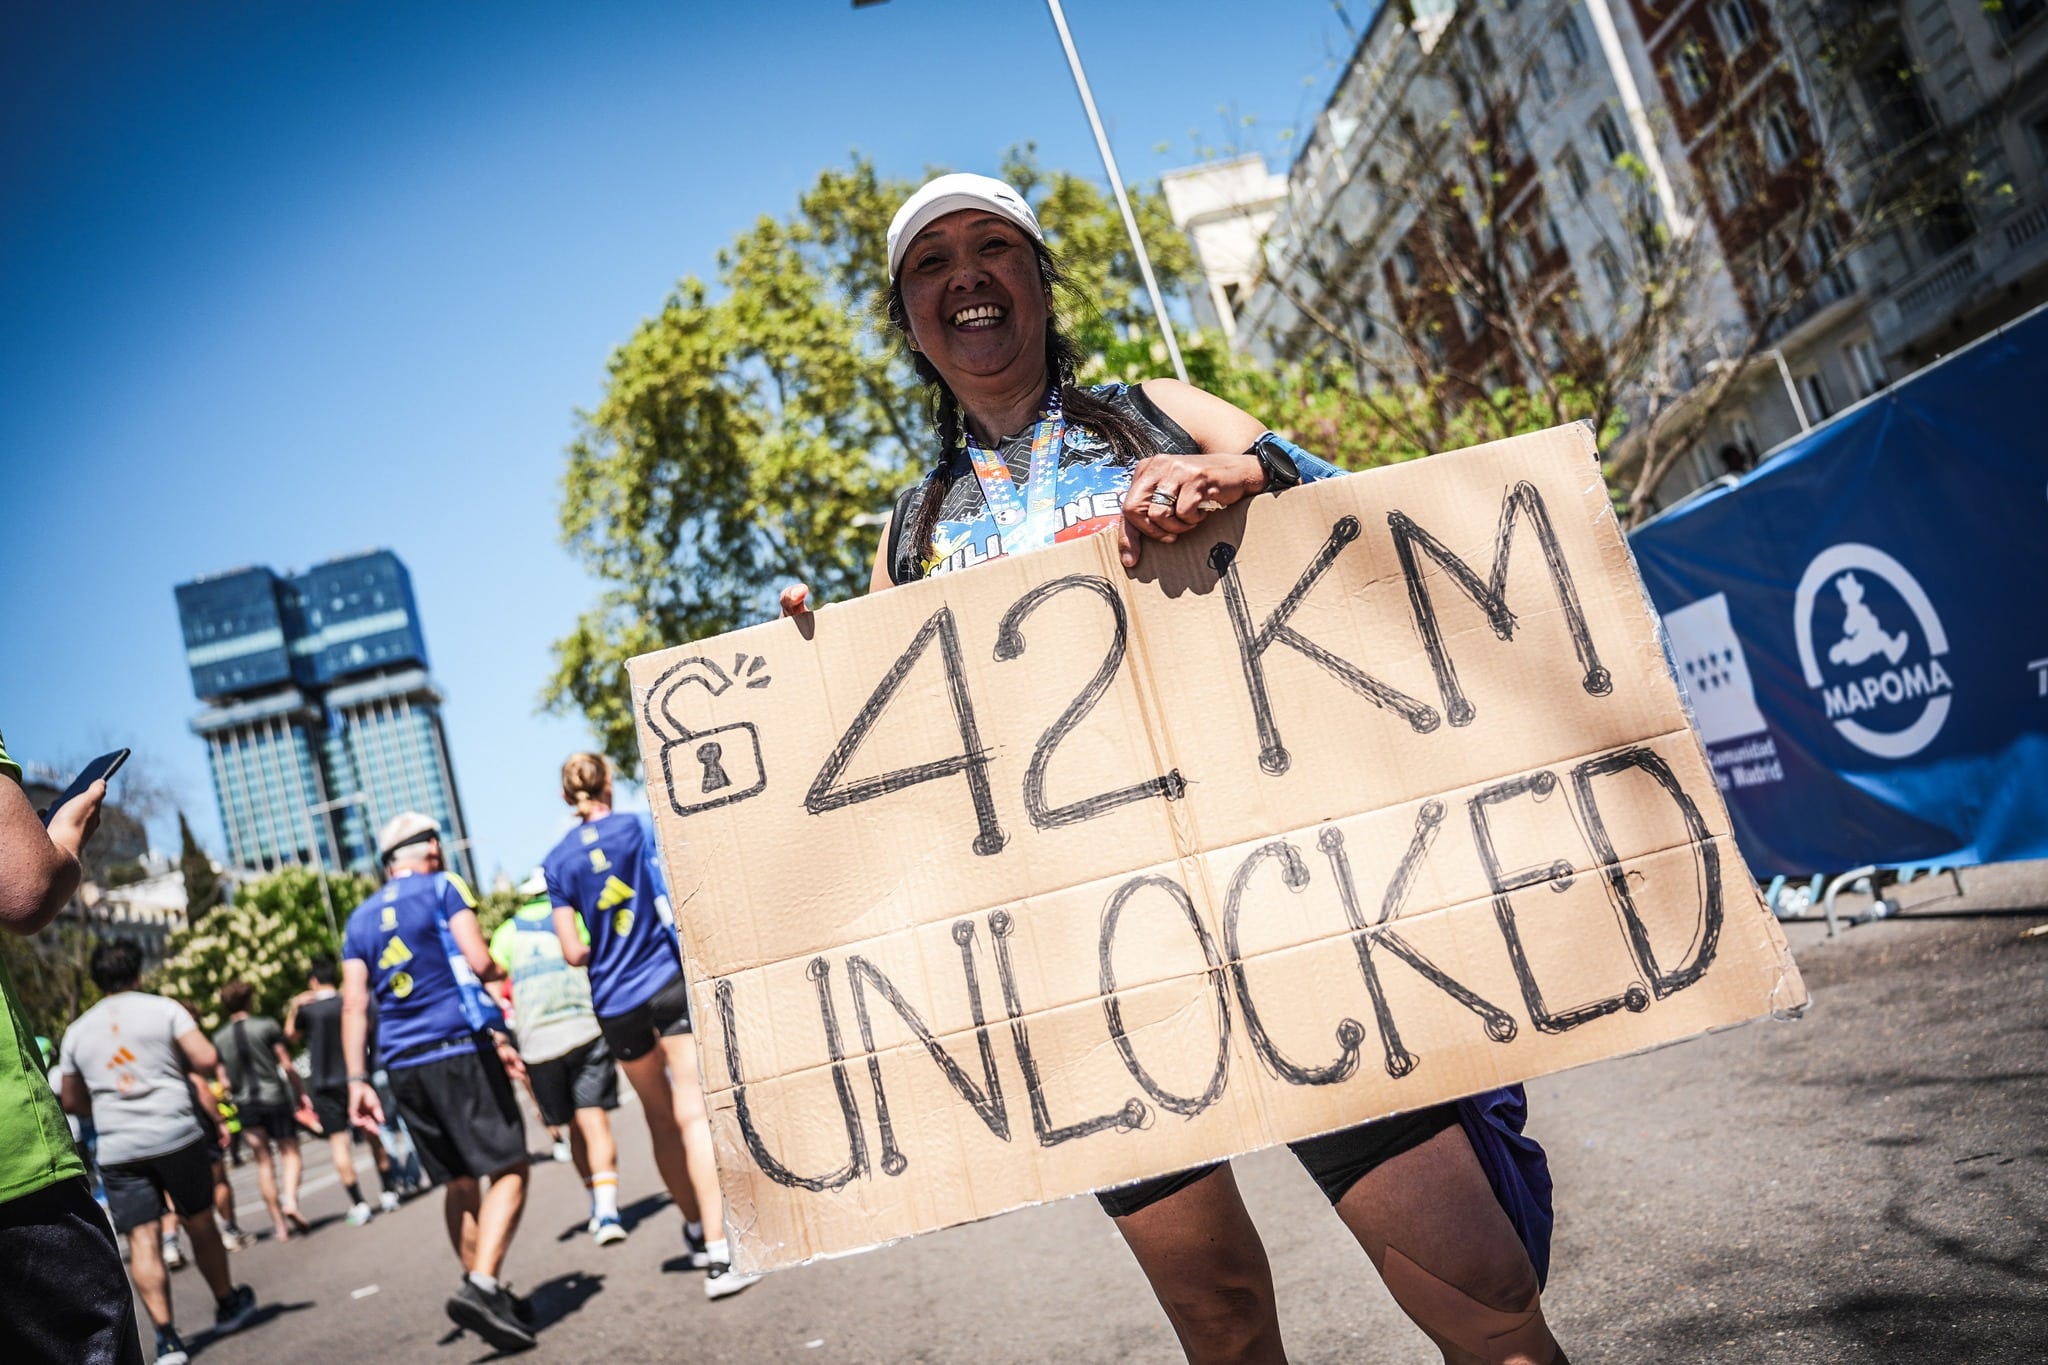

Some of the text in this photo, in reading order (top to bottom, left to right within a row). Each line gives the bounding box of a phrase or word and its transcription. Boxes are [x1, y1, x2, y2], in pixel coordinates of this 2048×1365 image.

[801, 480, 1613, 857] 42 KM
[1823, 659, 1954, 719] MAPOMA
[713, 746, 1725, 1193] UNLOCKED
